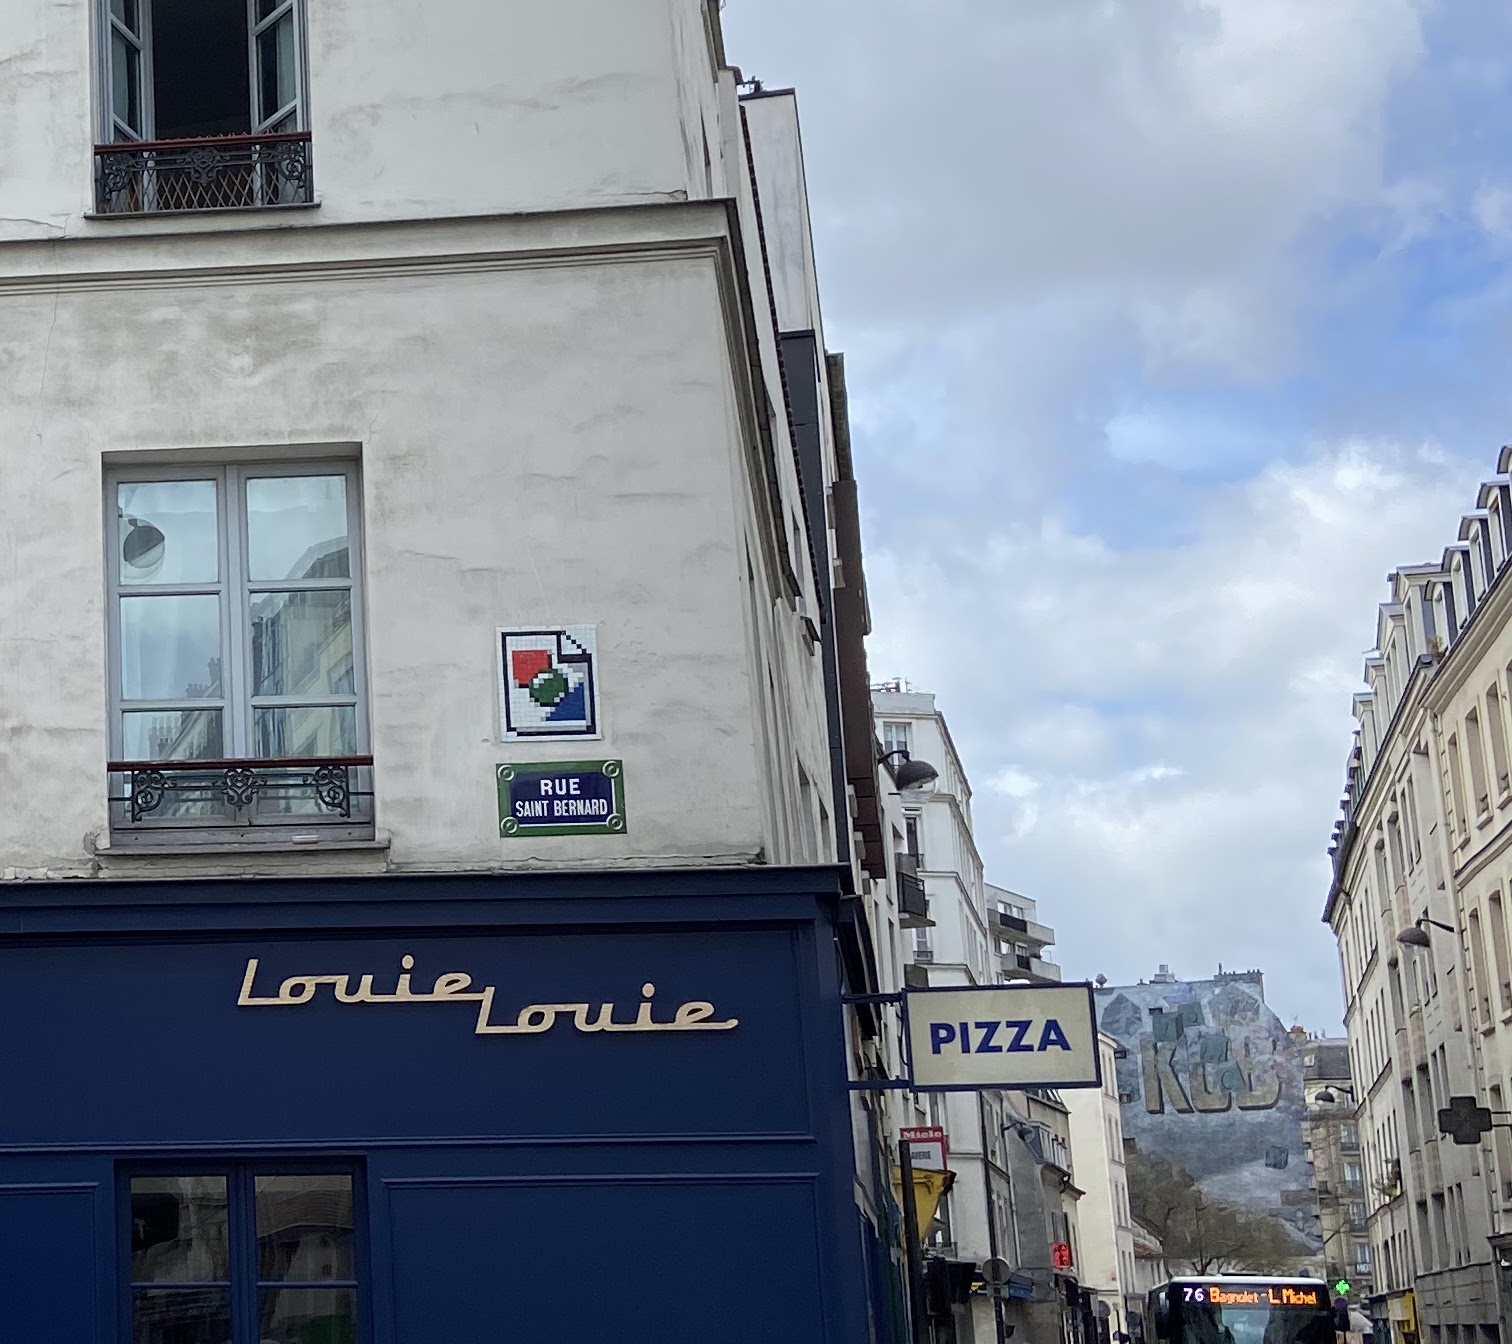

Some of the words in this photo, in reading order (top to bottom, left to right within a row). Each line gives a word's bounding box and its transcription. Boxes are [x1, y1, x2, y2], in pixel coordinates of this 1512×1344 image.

[540, 778, 581, 795] RUE
[515, 800, 550, 817] SAINT
[553, 798, 608, 816] BERNARD
[237, 954, 489, 1006] Louie
[474, 982, 739, 1034] Louie
[929, 1018, 1072, 1055] PIZZA
[902, 1130, 943, 1140] Miele
[1183, 1287, 1205, 1302] 76
[1209, 1286, 1259, 1304] Bagnolet
